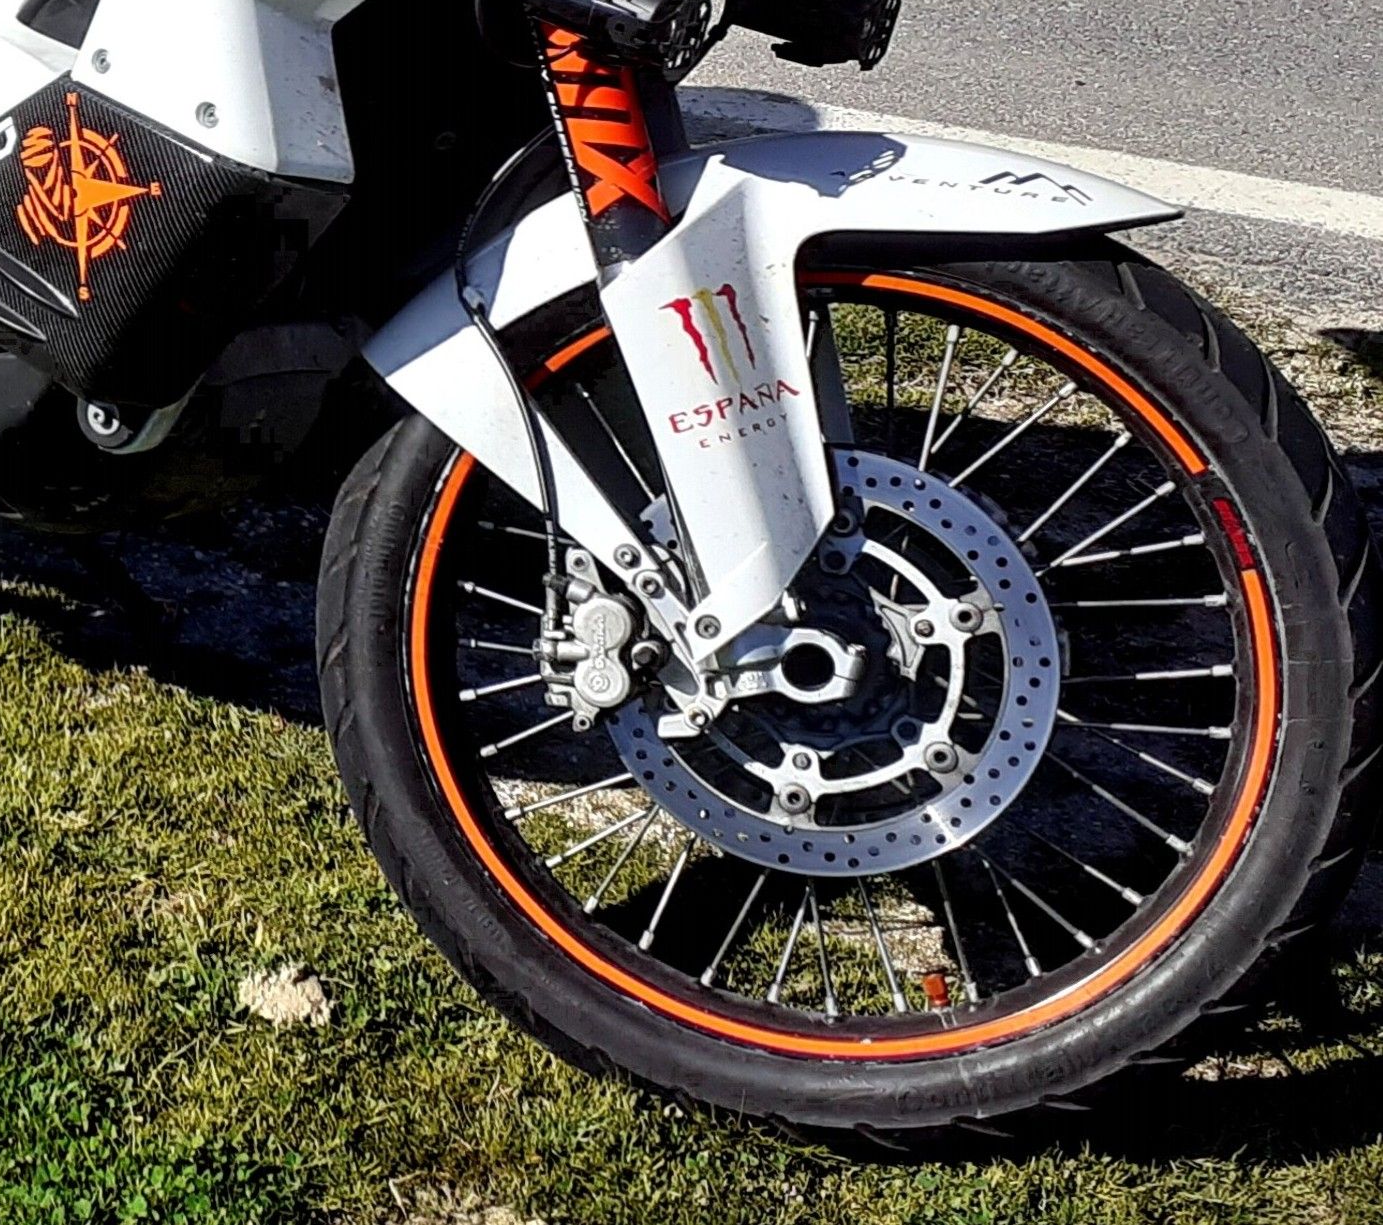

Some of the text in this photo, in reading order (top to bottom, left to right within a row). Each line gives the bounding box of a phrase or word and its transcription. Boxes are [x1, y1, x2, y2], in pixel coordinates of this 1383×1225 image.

[65, 91, 79, 106] N
[149, 182, 163, 196] E
[77, 285, 91, 301] S
[668, 379, 800, 434] ESPAÑA
[699, 412, 788, 450] ENERGY
